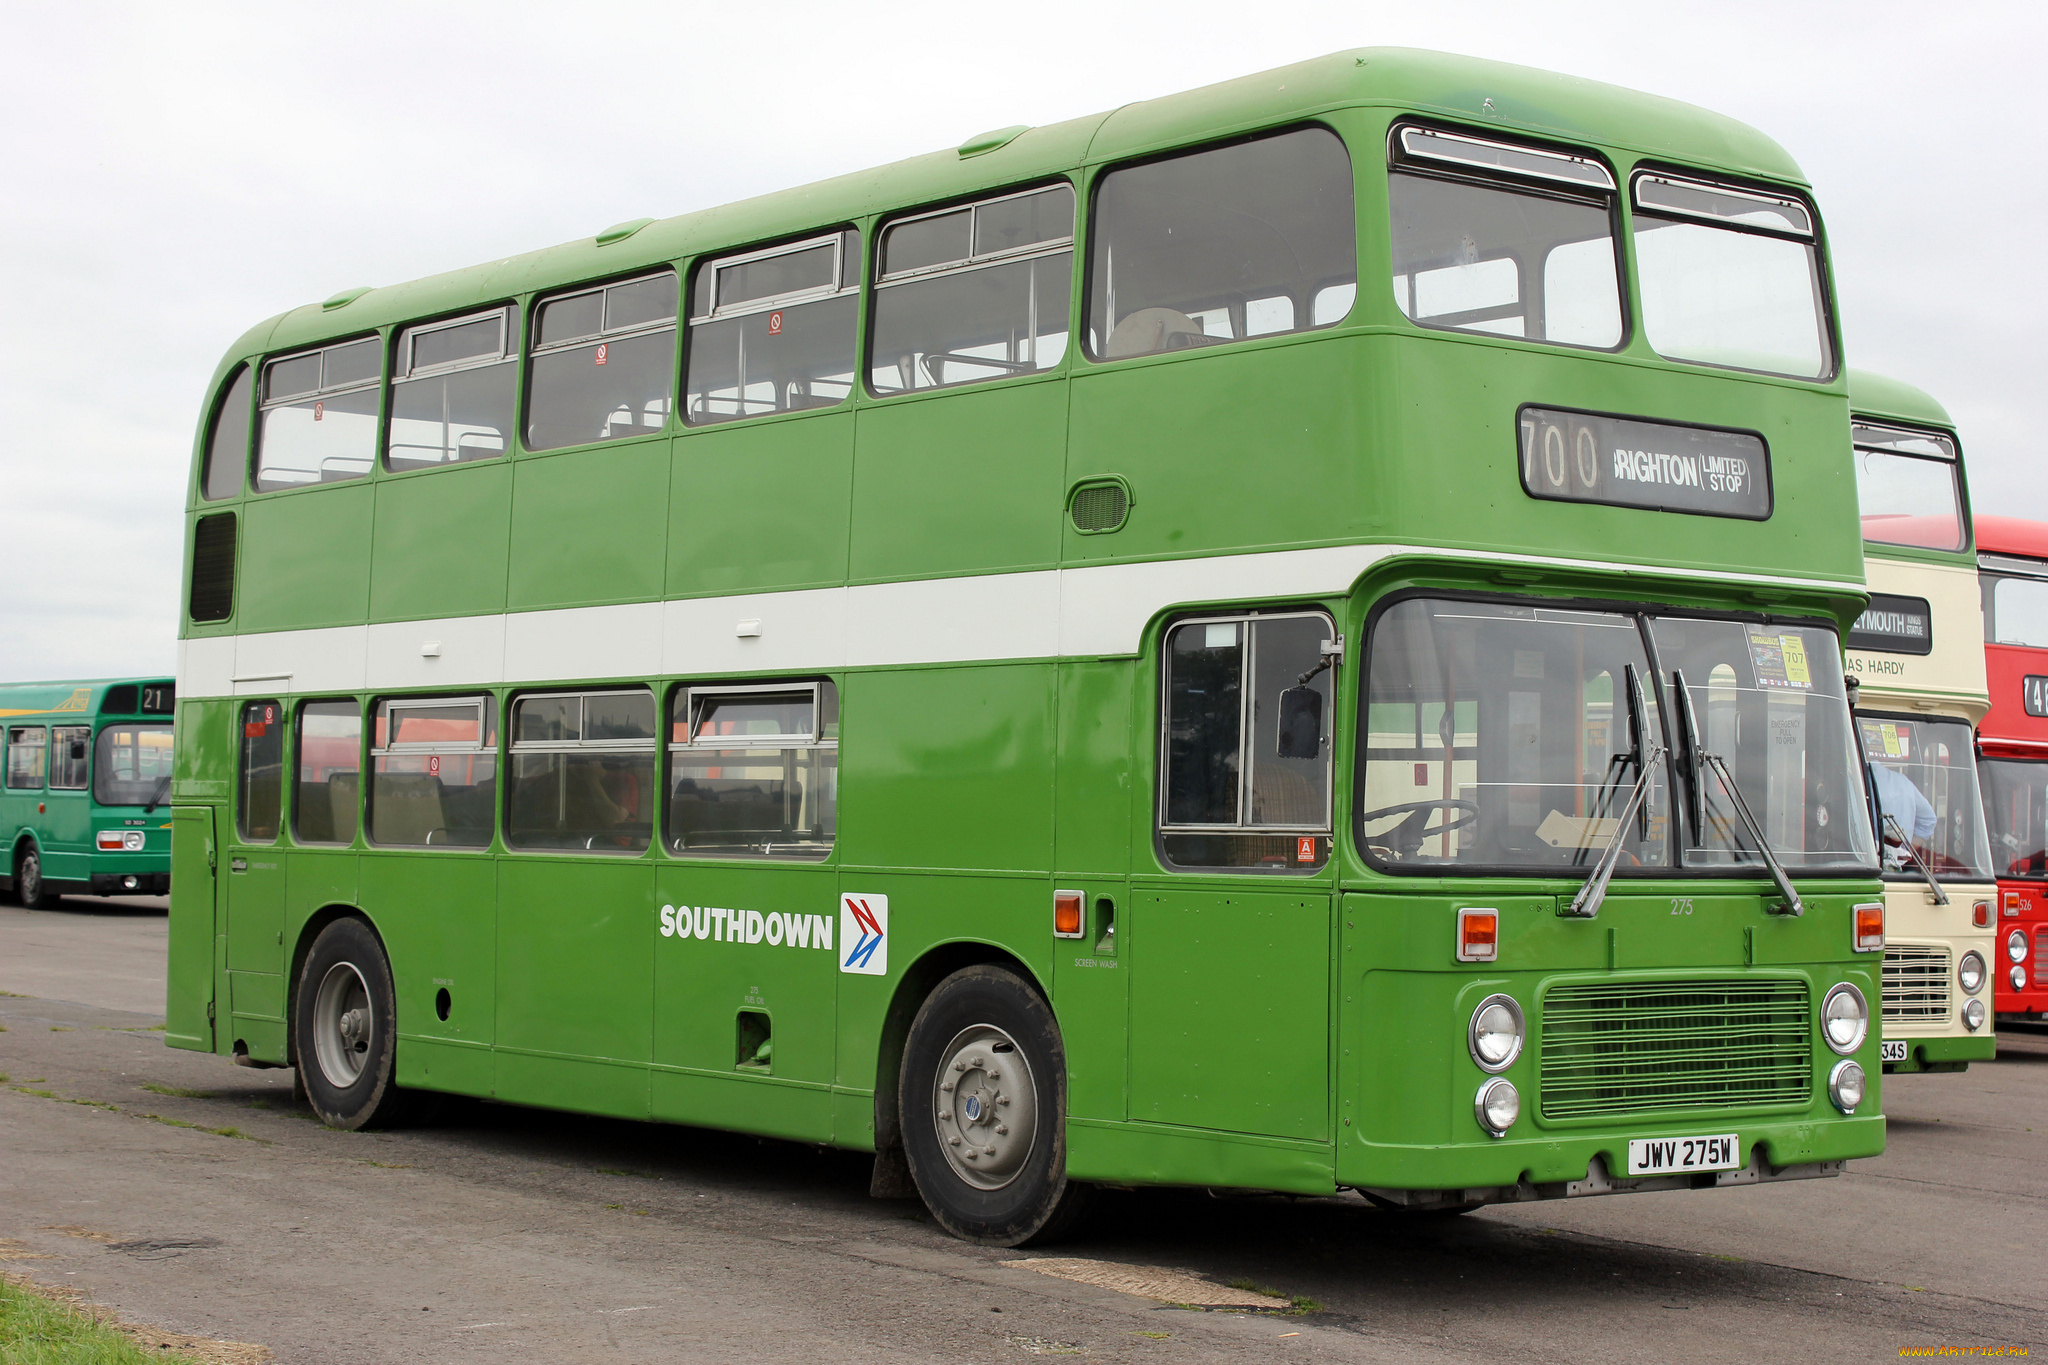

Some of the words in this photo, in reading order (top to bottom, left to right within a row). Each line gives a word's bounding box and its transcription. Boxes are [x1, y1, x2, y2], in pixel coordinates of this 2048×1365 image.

[1521, 421, 1598, 488] 700
[1702, 455, 1746, 476] LIMITED
[1710, 474, 1742, 493] STOP
[1906, 615, 1921, 625] KINGS
[1906, 625, 1923, 636] STATUE
[1785, 652, 1804, 664] 707
[1844, 657, 1863, 672] AS
[1868, 660, 1905, 675] HARDY
[143, 688, 162, 710] 21
[1771, 720, 1800, 728] EMERGENCY
[1780, 728, 1791, 736] PULL
[1775, 736, 1783, 745] TO
[1783, 736, 1797, 745] OPEN
[1301, 841, 1311, 853] A
[1670, 898, 1693, 915] 275
[2019, 898, 2033, 911] 526
[659, 904, 834, 951] SOUTHDOWN
[1074, 958, 1098, 968] SCREEN
[1099, 959, 1118, 969] WASH
[1638, 1142, 1676, 1168] JWV
[1683, 1138, 1731, 1166] 275W
